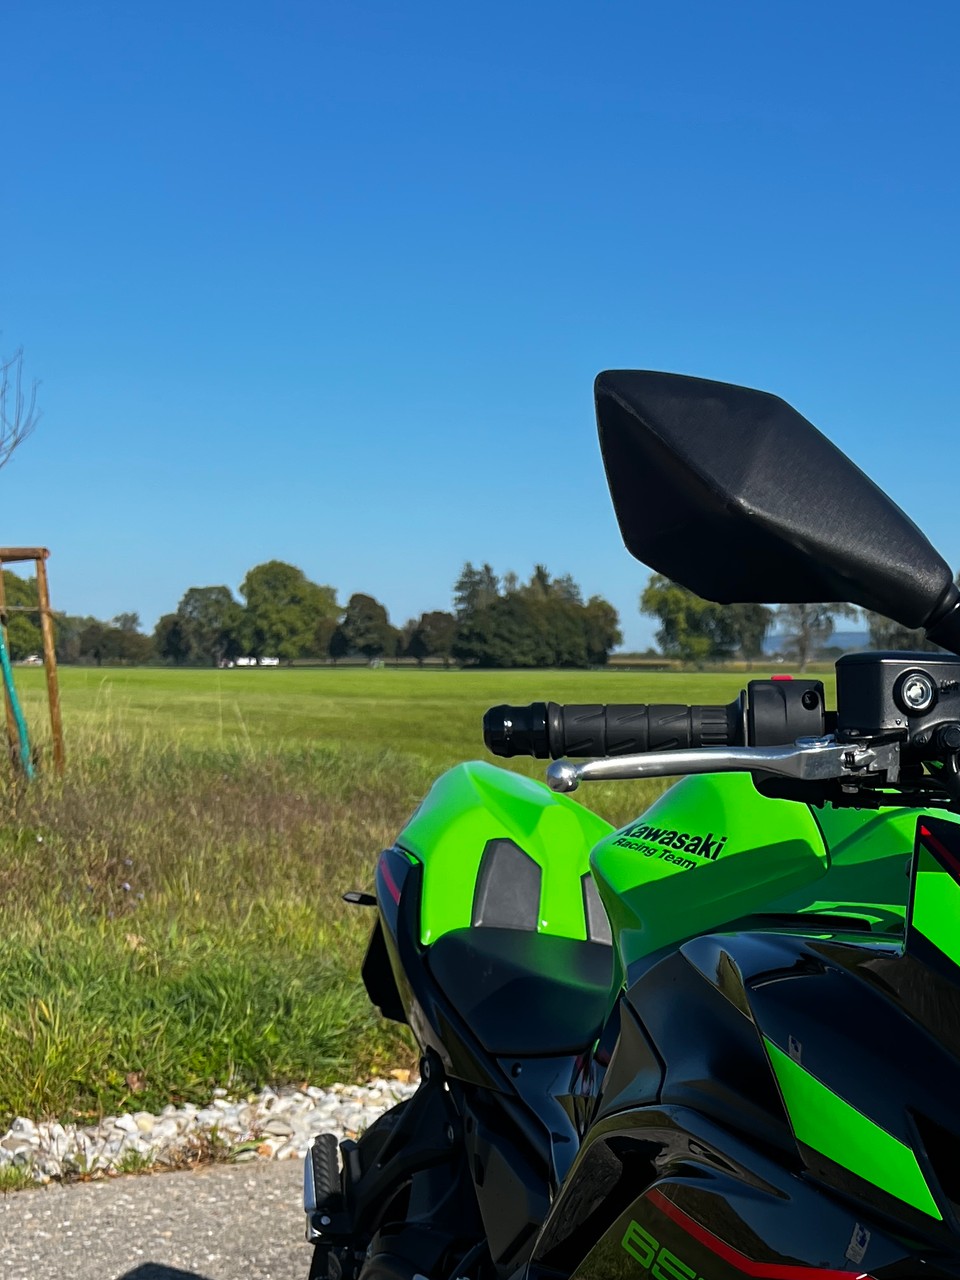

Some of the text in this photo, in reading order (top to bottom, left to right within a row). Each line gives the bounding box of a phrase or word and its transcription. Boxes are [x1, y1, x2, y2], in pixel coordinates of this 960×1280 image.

[612, 837, 698, 870] Racing Team
[617, 823, 728, 861] Kawasaki
